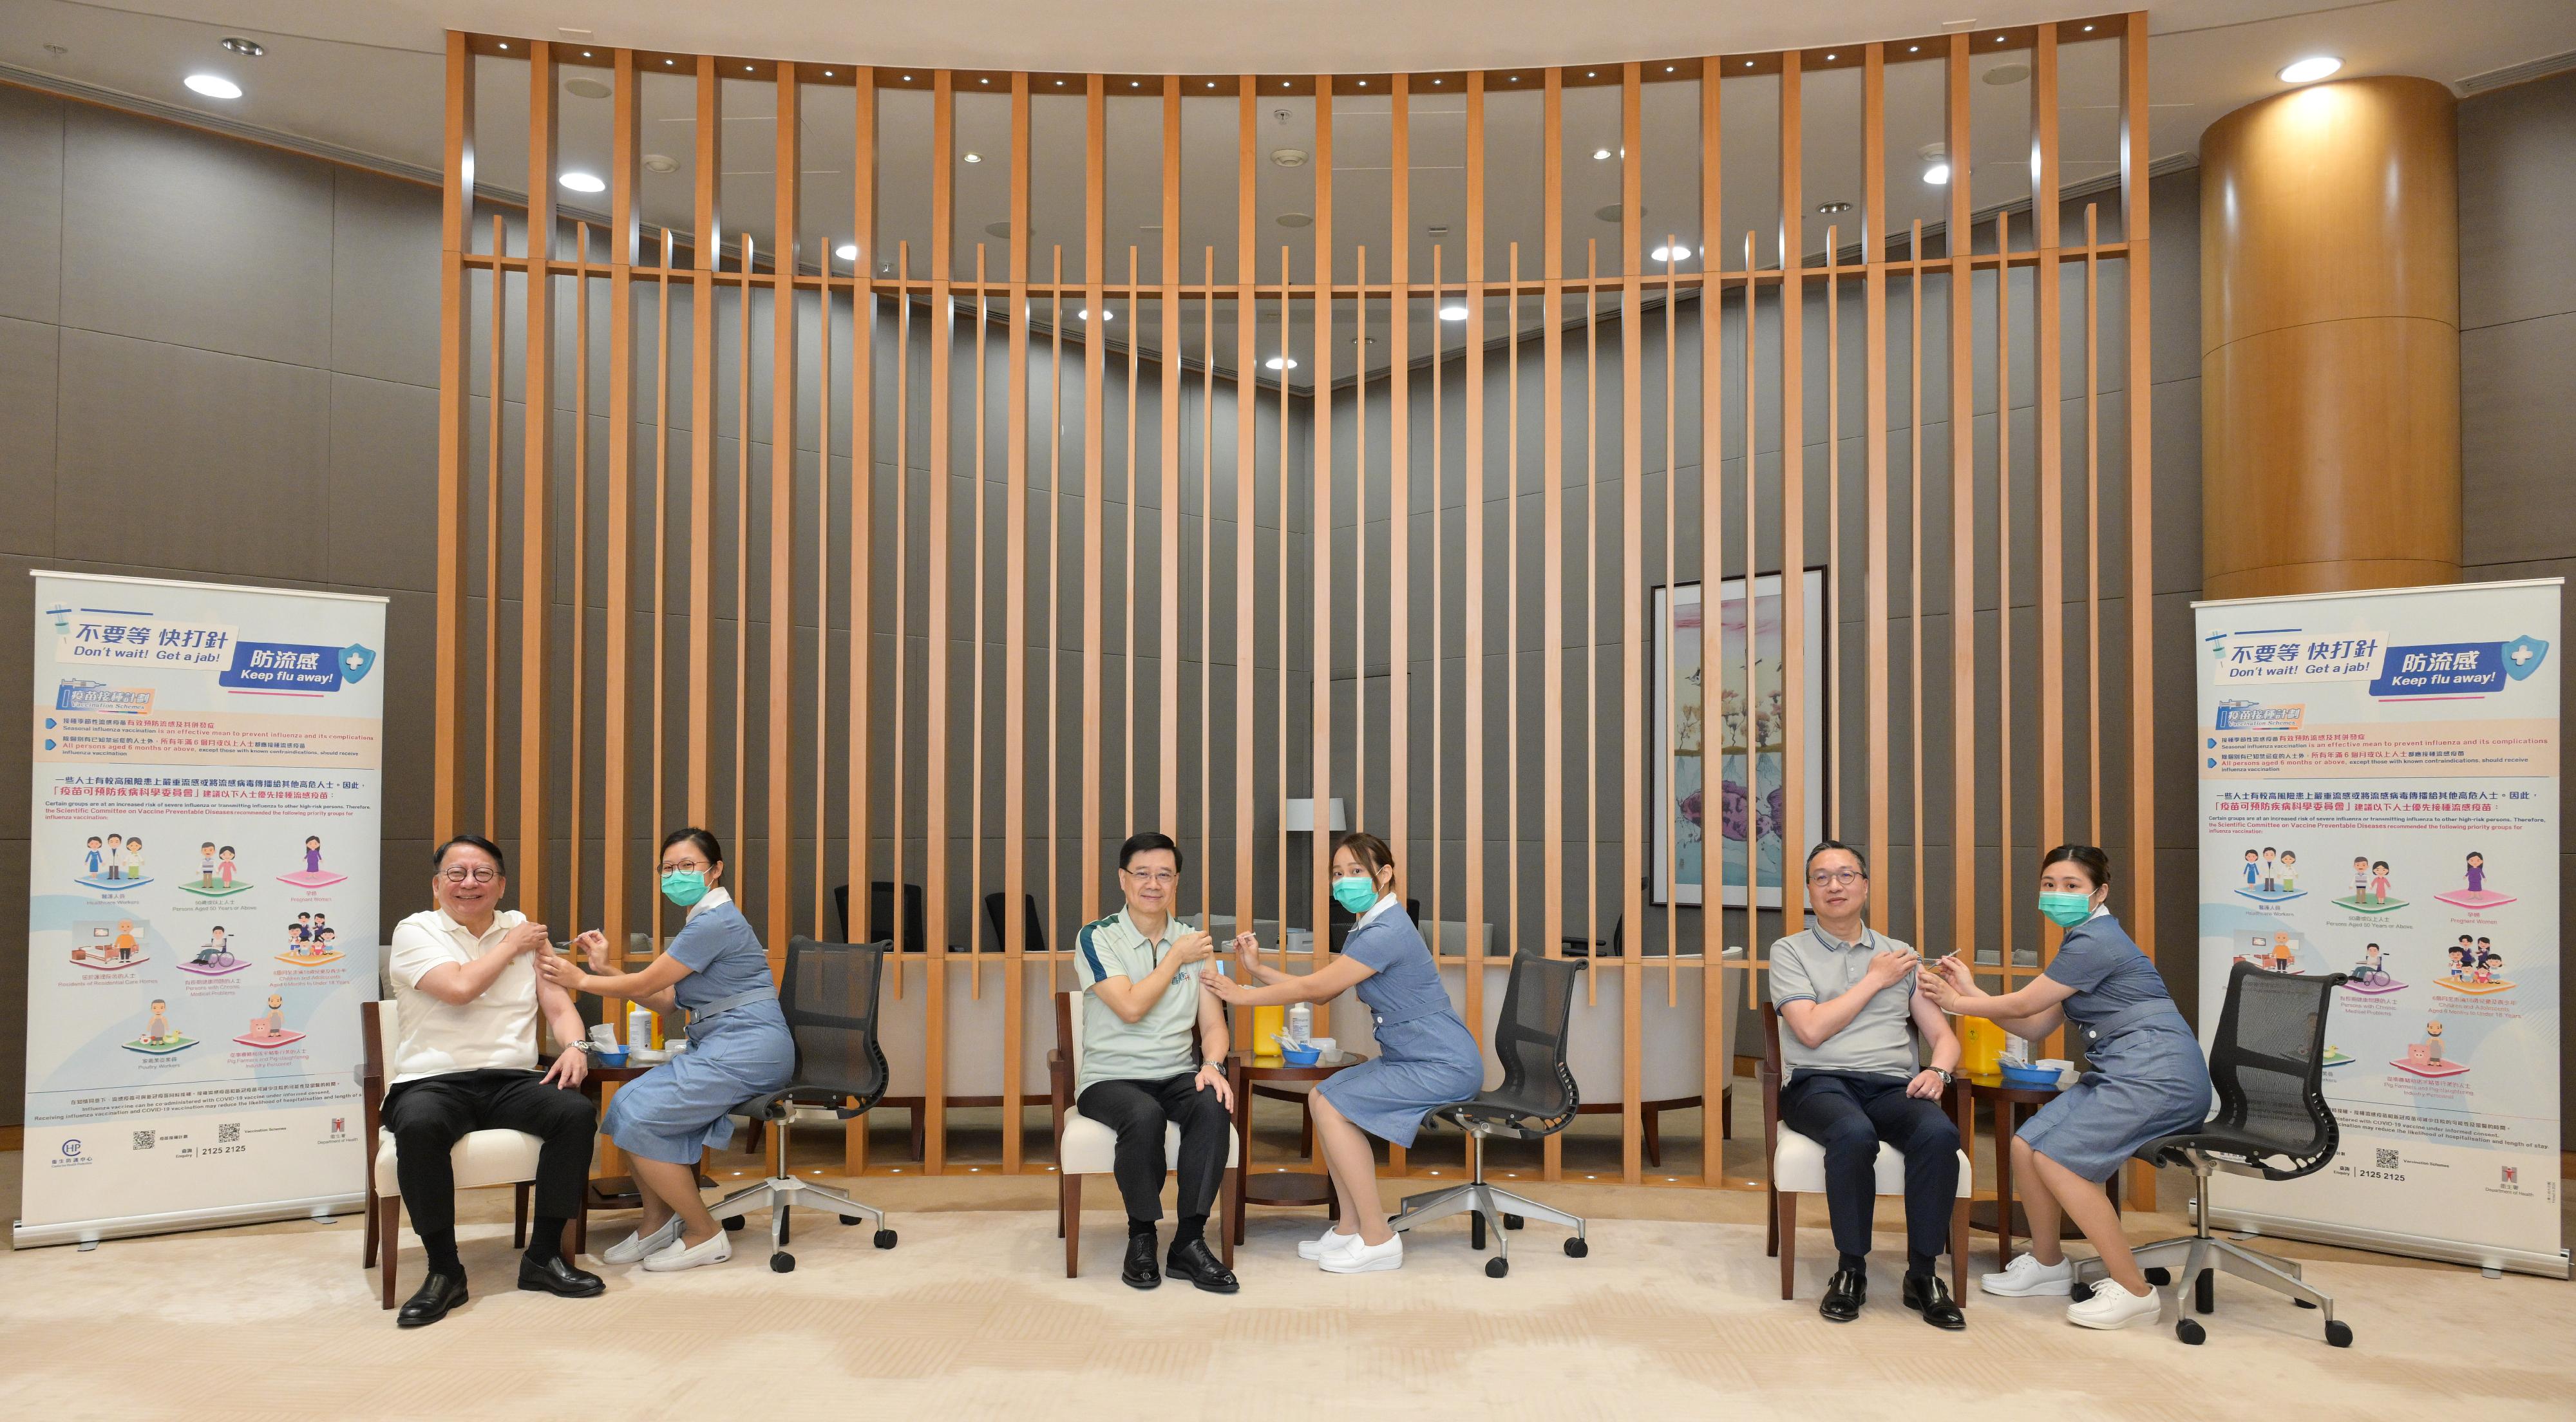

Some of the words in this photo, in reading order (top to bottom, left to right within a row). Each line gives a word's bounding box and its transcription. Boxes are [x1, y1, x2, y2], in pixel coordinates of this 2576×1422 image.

[76, 623, 151, 645] 不要等
[159, 629, 228, 649] 快打針
[74, 646, 111, 656] Don't
[115, 649, 148, 658] wait!
[156, 650, 180, 659] Get
[194, 652, 220, 663] jab!
[2231, 643, 2300, 663] 不要等
[2307, 639, 2378, 660] 快打針
[250, 650, 319, 670] 防流感
[2401, 650, 2479, 672] 防流感
[241, 669, 273, 681] Keep
[277, 671, 294, 680] flu
[296, 674, 333, 684] away!
[2230, 667, 2262, 677] Don't
[2267, 665, 2298, 675] wait!
[2306, 664, 2329, 674] Get
[2343, 662, 2369, 674] jab!
[2392, 676, 2427, 687] Keep
[2431, 674, 2450, 684] flu
[2453, 672, 2496, 684] away!
[71, 690, 149, 703] 疫苗接種計劃
[2228, 708, 2300, 720] 疫苗接種計劃
[1171, 972, 1187, 985] 香港
[2360, 1170, 2381, 1178] 2125
[2383, 1173, 2405, 1181] 2125
